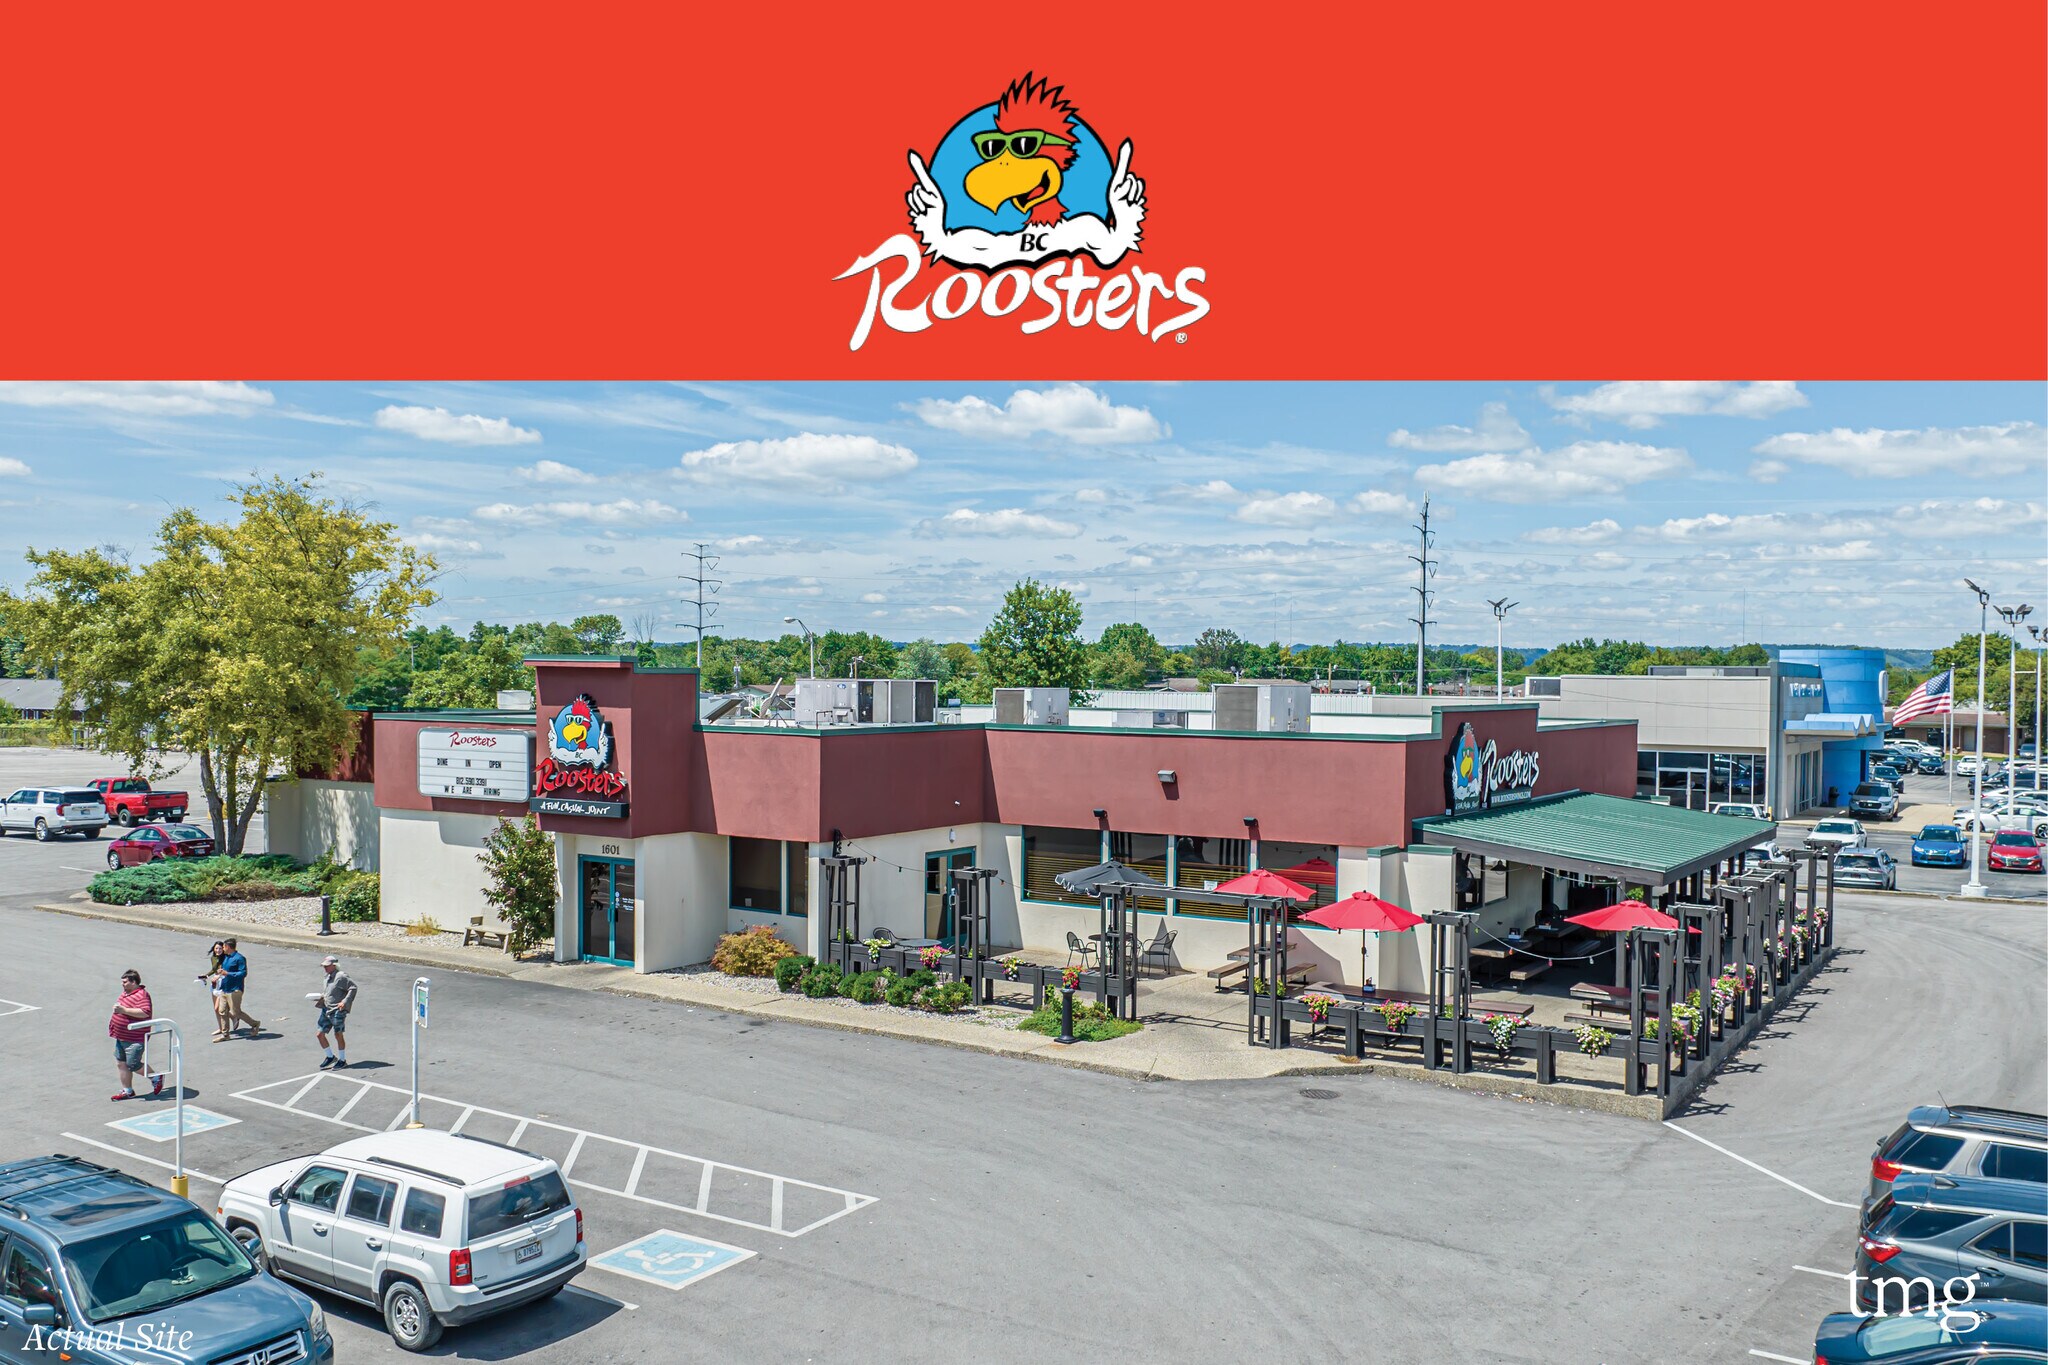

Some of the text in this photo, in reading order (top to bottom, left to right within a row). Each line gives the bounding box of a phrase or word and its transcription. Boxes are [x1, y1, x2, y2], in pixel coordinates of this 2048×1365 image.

[449, 731, 496, 747] Roosters
[465, 759, 471, 767] IN
[489, 760, 502, 769] OPEN
[1482, 739, 1539, 802] Roosters
[534, 757, 626, 797] Roosters
[462, 786, 472, 794] ARE
[484, 787, 500, 796] HIRING
[540, 801, 546, 810] A
[585, 805, 611, 815] JOINT
[602, 844, 620, 855] 1601
